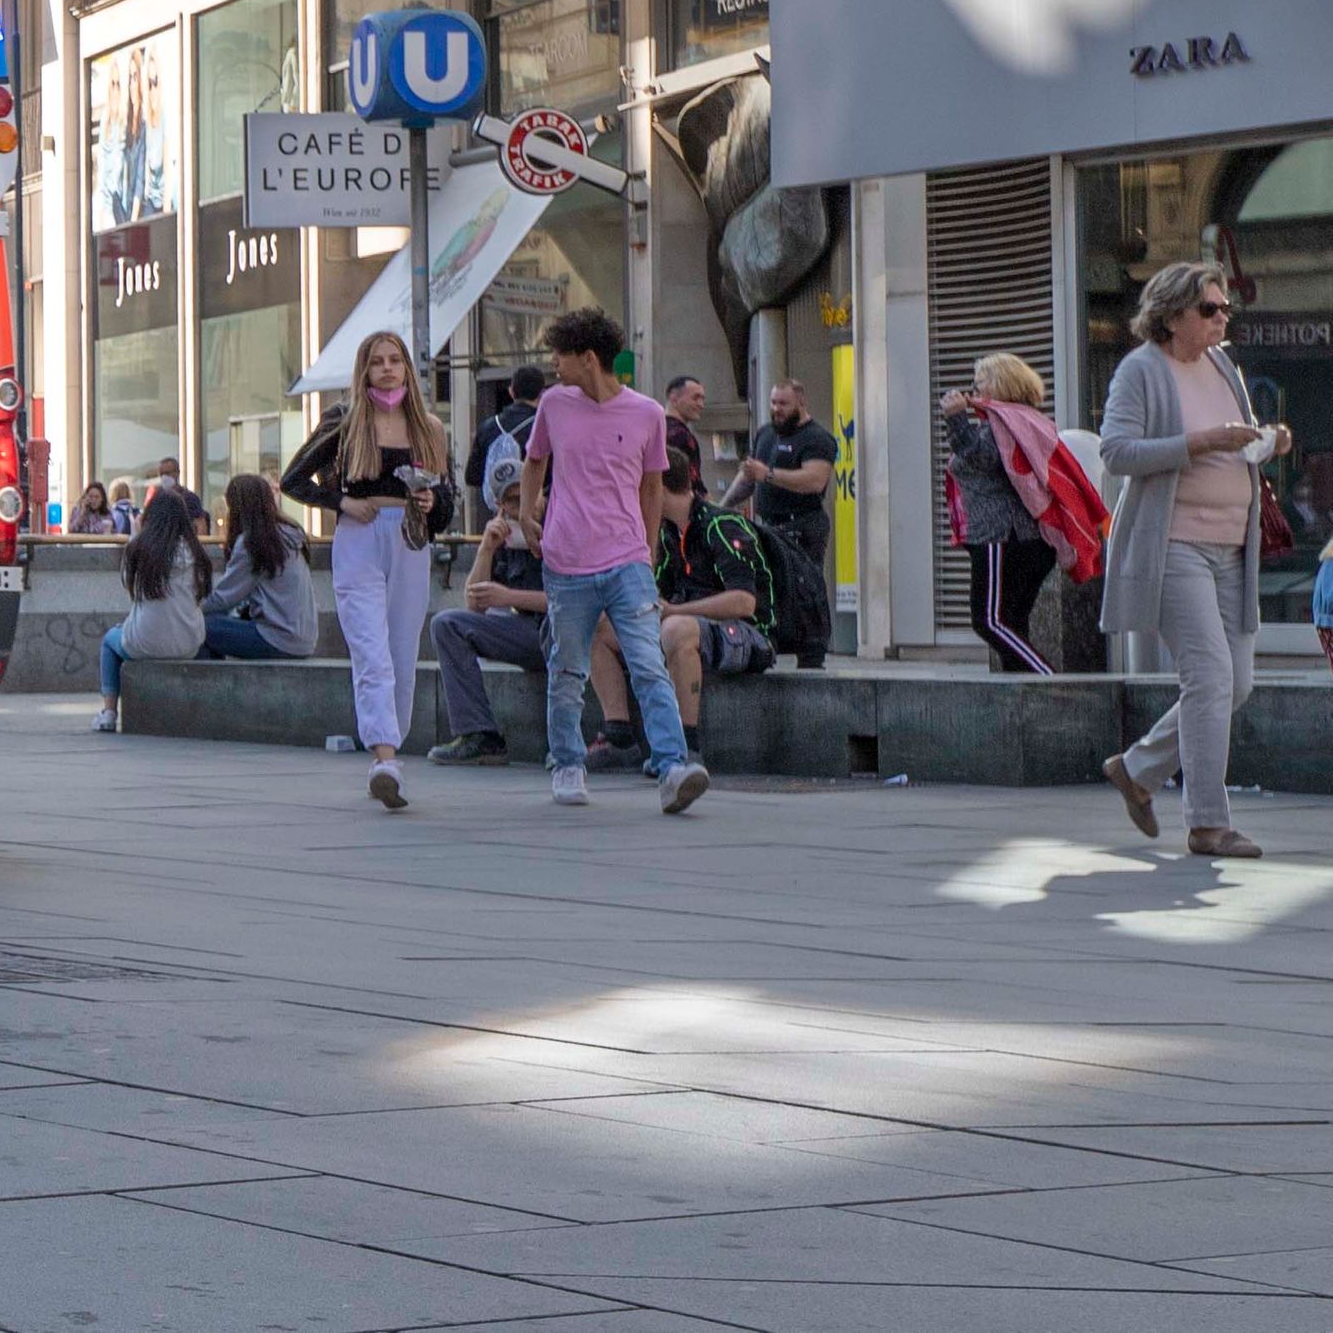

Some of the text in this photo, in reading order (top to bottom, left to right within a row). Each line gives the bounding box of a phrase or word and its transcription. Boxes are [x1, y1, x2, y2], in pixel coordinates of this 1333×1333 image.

[352, 32, 376, 109] U
[404, 30, 469, 104] U
[1129, 31, 1252, 77] ZARA
[278, 128, 365, 156] CAFÉ
[519, 112, 583, 148] TABAK
[509, 144, 568, 190] TRAFIK
[226, 230, 278, 286] Jones
[115, 257, 160, 309] Jones
